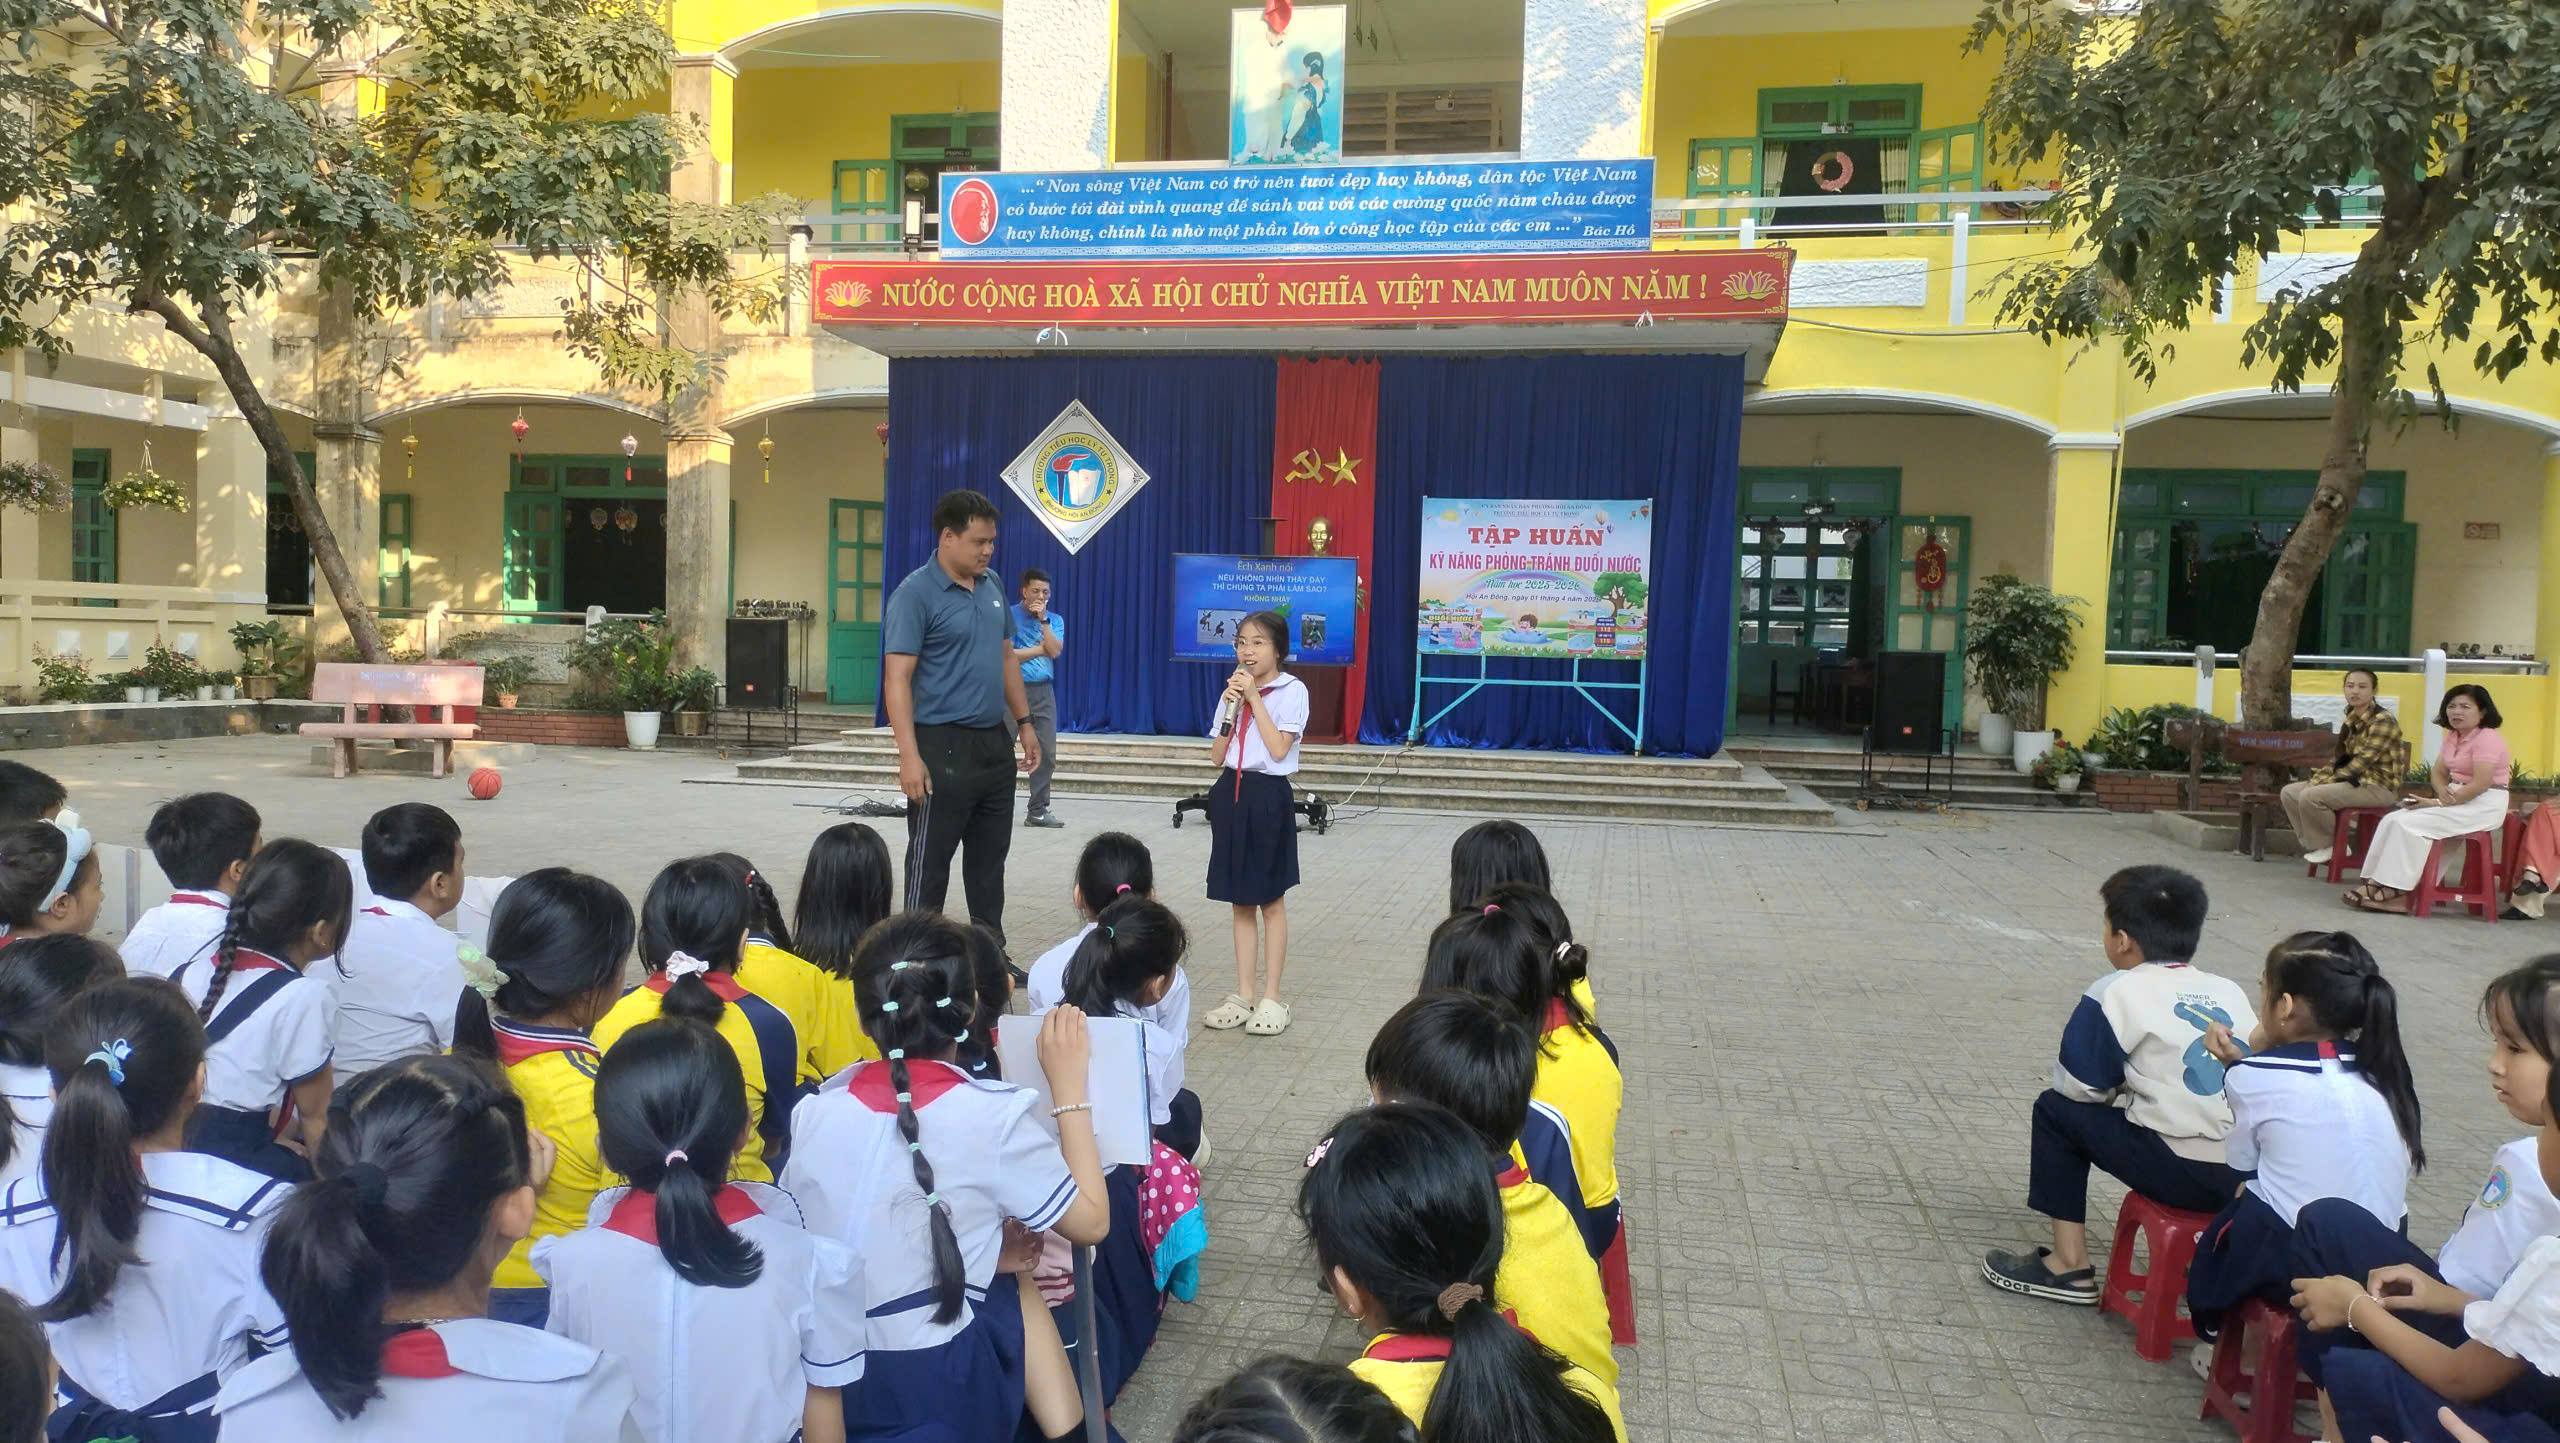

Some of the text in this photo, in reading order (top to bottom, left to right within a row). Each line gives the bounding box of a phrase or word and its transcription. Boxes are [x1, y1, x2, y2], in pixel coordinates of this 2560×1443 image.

[1086, 179, 1124, 195] sông
[1129, 177, 1162, 194] Việt
[1167, 176, 1205, 190] Nam
[1210, 175, 1229, 190] có
[1233, 174, 1261, 190] trở
[1264, 174, 1295, 189] nên
[1300, 172, 1335, 188] tươi
[1339, 171, 1372, 190] đẹp
[1375, 170, 1409, 189] hay
[1413, 170, 1473, 188] không,
[1478, 169, 1514, 184] dân
[1519, 169, 1546, 186] tộc
[1552, 167, 1589, 184] Việt
[1592, 166, 1638, 182] Nam
[1006, 190, 1637, 217] có bước tới đài vinh quang để sánh vai với các cường quốc năm châu được
[1006, 226, 1036, 242] hay
[1039, 225, 1094, 242] không,
[1098, 224, 1147, 239] chính
[1150, 223, 1168, 238] là
[1171, 222, 1206, 238] nhờ
[1208, 223, 1240, 240] một
[1242, 220, 1288, 240] phần
[1292, 221, 1321, 237] lớn
[1323, 221, 1337, 236] ở
[1339, 221, 1381, 238] công
[1384, 220, 1415, 237] học
[1419, 220, 1449, 237] tập
[1453, 219, 1487, 234] của
[1490, 218, 1521, 233] các
[1525, 222, 1551, 232] em
[1582, 223, 1636, 237] Bác Hồ
[882, 276, 955, 307] NƯỚC
[963, 278, 1037, 314] CỘNG
[1043, 276, 1101, 308] HOÀ
[1107, 277, 1144, 308] XÃ
[1151, 276, 1203, 313] HỘI
[1210, 272, 1270, 307] CHỦ
[1277, 274, 1369, 306] NGHĨA
[1376, 272, 1444, 311] VIỆT
[1450, 278, 1517, 303] NAM
[1524, 271, 1615, 303] MUÔN
[1621, 268, 1691, 301] NĂM
[1467, 523, 1604, 548] TẬP HUẤN
[1429, 551, 1446, 569] KỸ
[1448, 551, 1482, 570] NĂNG
[1574, 550, 1604, 572] ĐUỐI
[1607, 554, 1642, 574] NƯỚC
[1989, 1272, 2031, 1292] crocs
